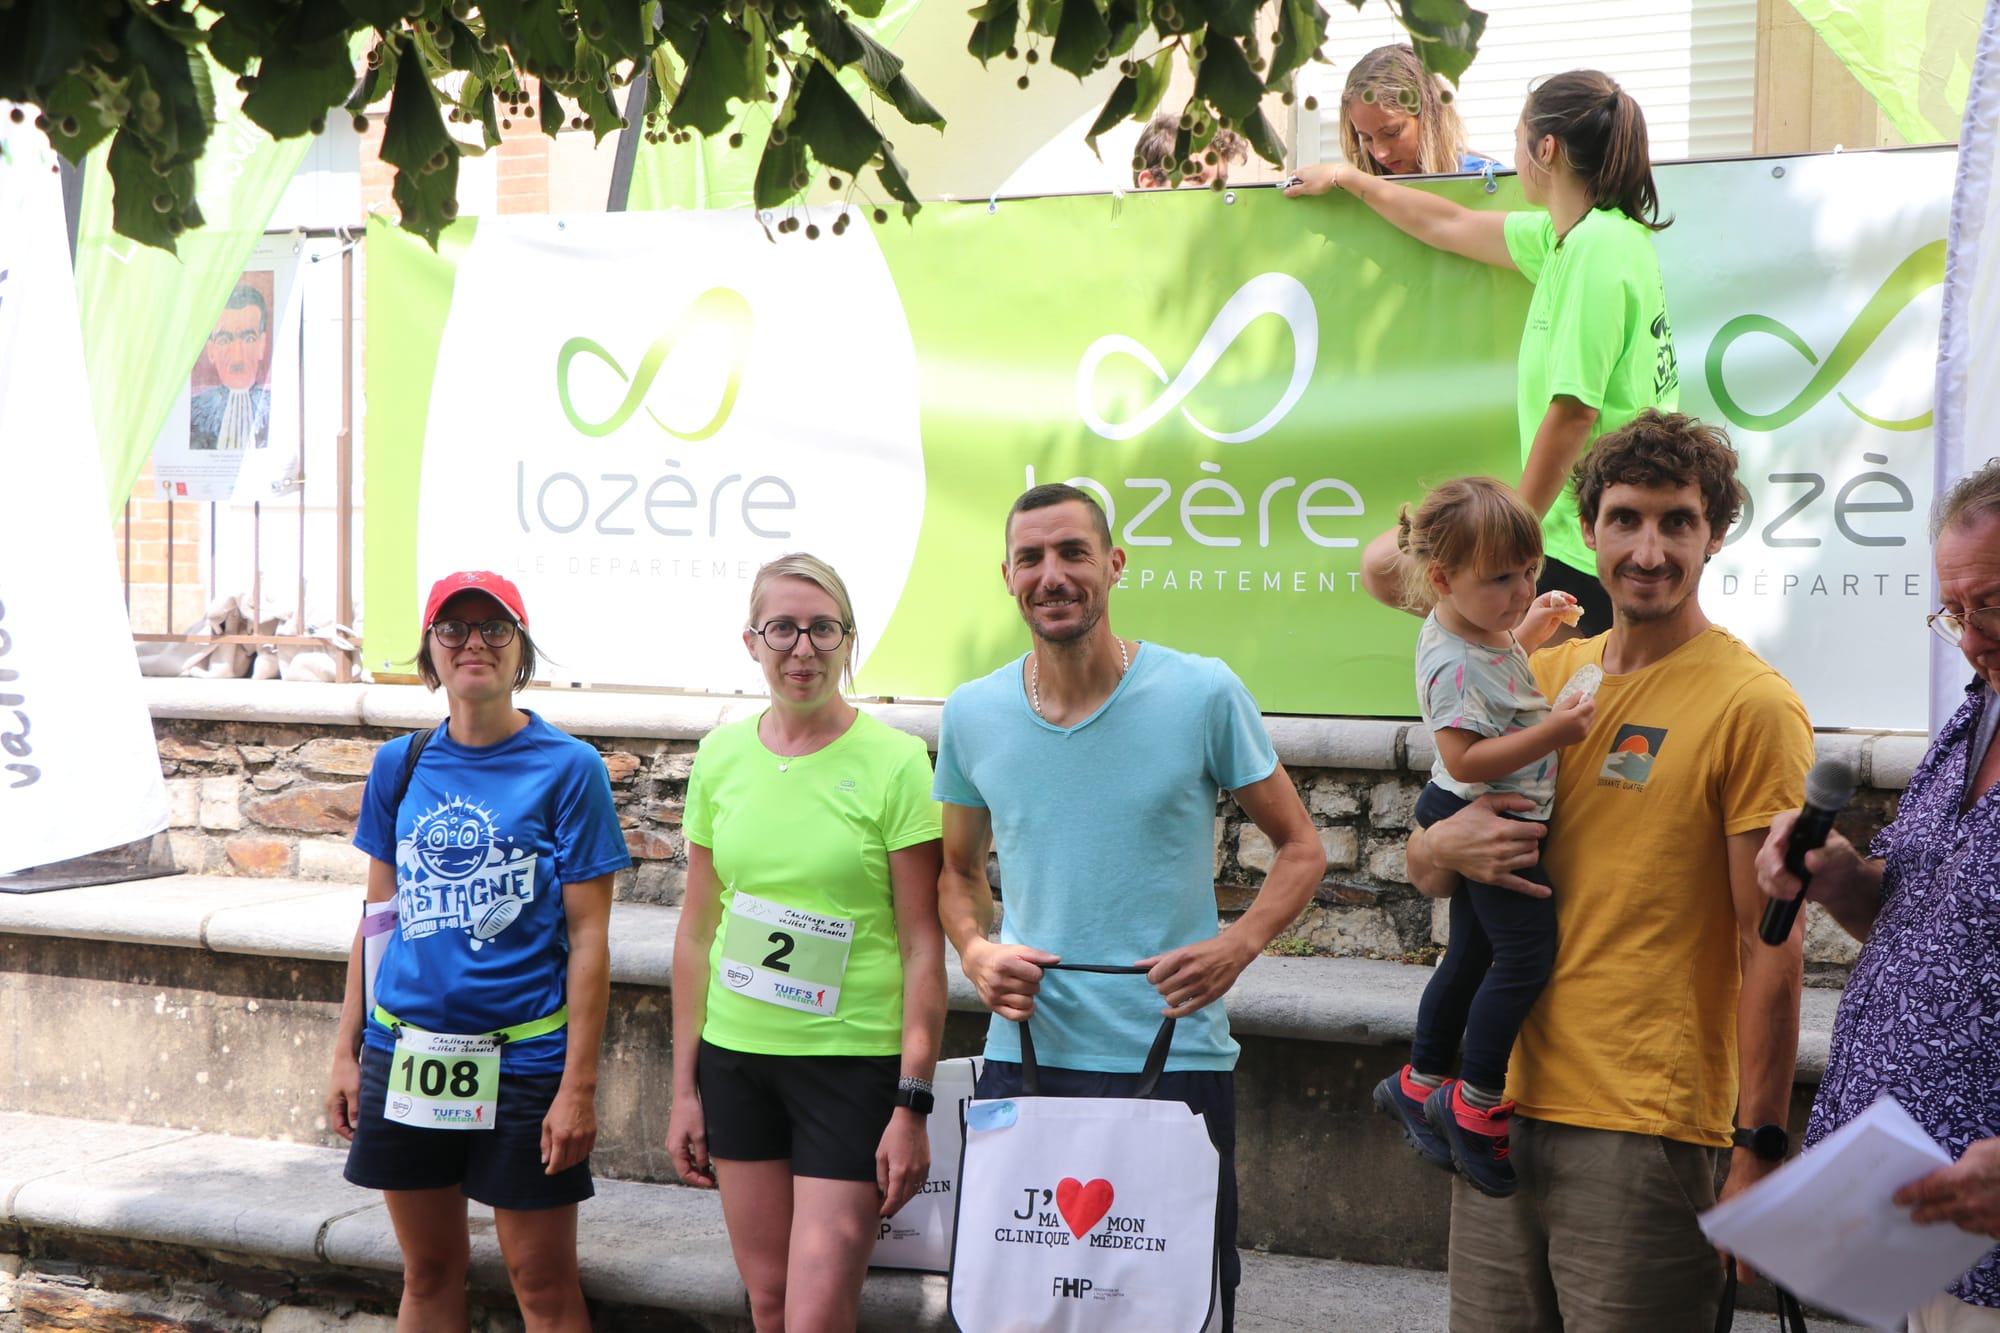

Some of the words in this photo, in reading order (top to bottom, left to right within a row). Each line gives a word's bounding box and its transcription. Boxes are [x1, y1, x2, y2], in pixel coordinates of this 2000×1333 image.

[516, 458, 797, 540] lozère
[568, 557, 764, 579] DEPARTEME
[1117, 569, 1360, 592] EPARTEMENT
[1723, 569, 1920, 596] DÉPARTE
[399, 868, 531, 923] CASTAGNE
[784, 910, 825, 926] Challenge
[830, 921, 845, 929] des
[761, 931, 795, 973] 2
[774, 983, 813, 999] TUFF'S
[432, 1036, 474, 1048] Challenge
[401, 1055, 479, 1098] 108
[432, 1108, 472, 1117] TUFF'S
[1038, 1212, 1059, 1227] MA
[1107, 1217, 1145, 1233] MON
[994, 1228, 1070, 1246] CLINIQUE
[1090, 1232, 1166, 1252] MÉDECIN
[1052, 1276, 1093, 1299] FHP
